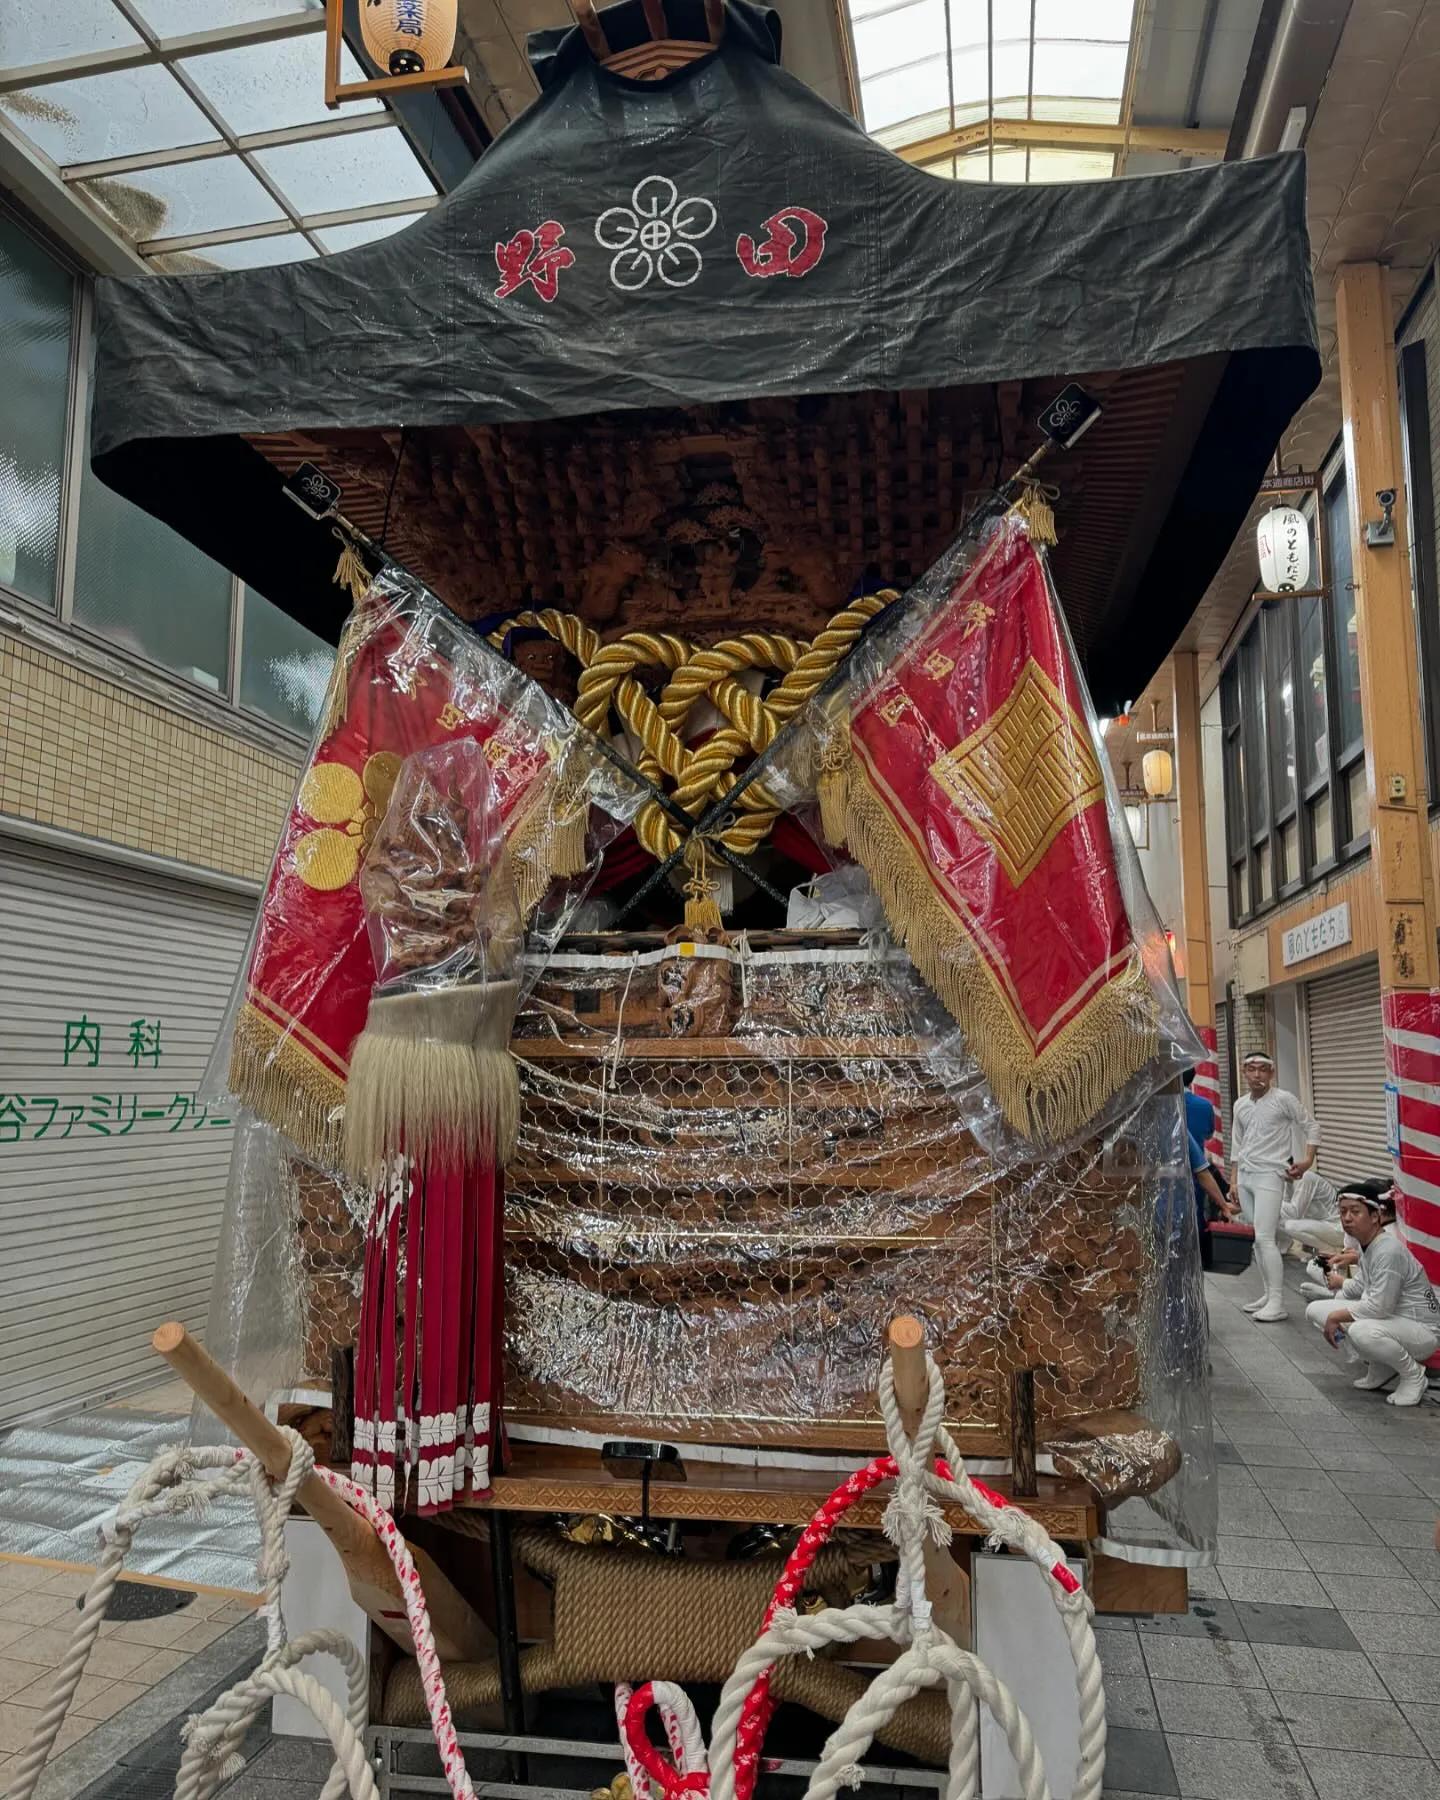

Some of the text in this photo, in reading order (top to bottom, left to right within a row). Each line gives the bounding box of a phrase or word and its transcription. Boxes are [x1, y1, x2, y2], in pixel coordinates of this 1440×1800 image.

[1283, 513, 1300, 582] 風のともだち
[63, 1014, 162, 1069] 内科
